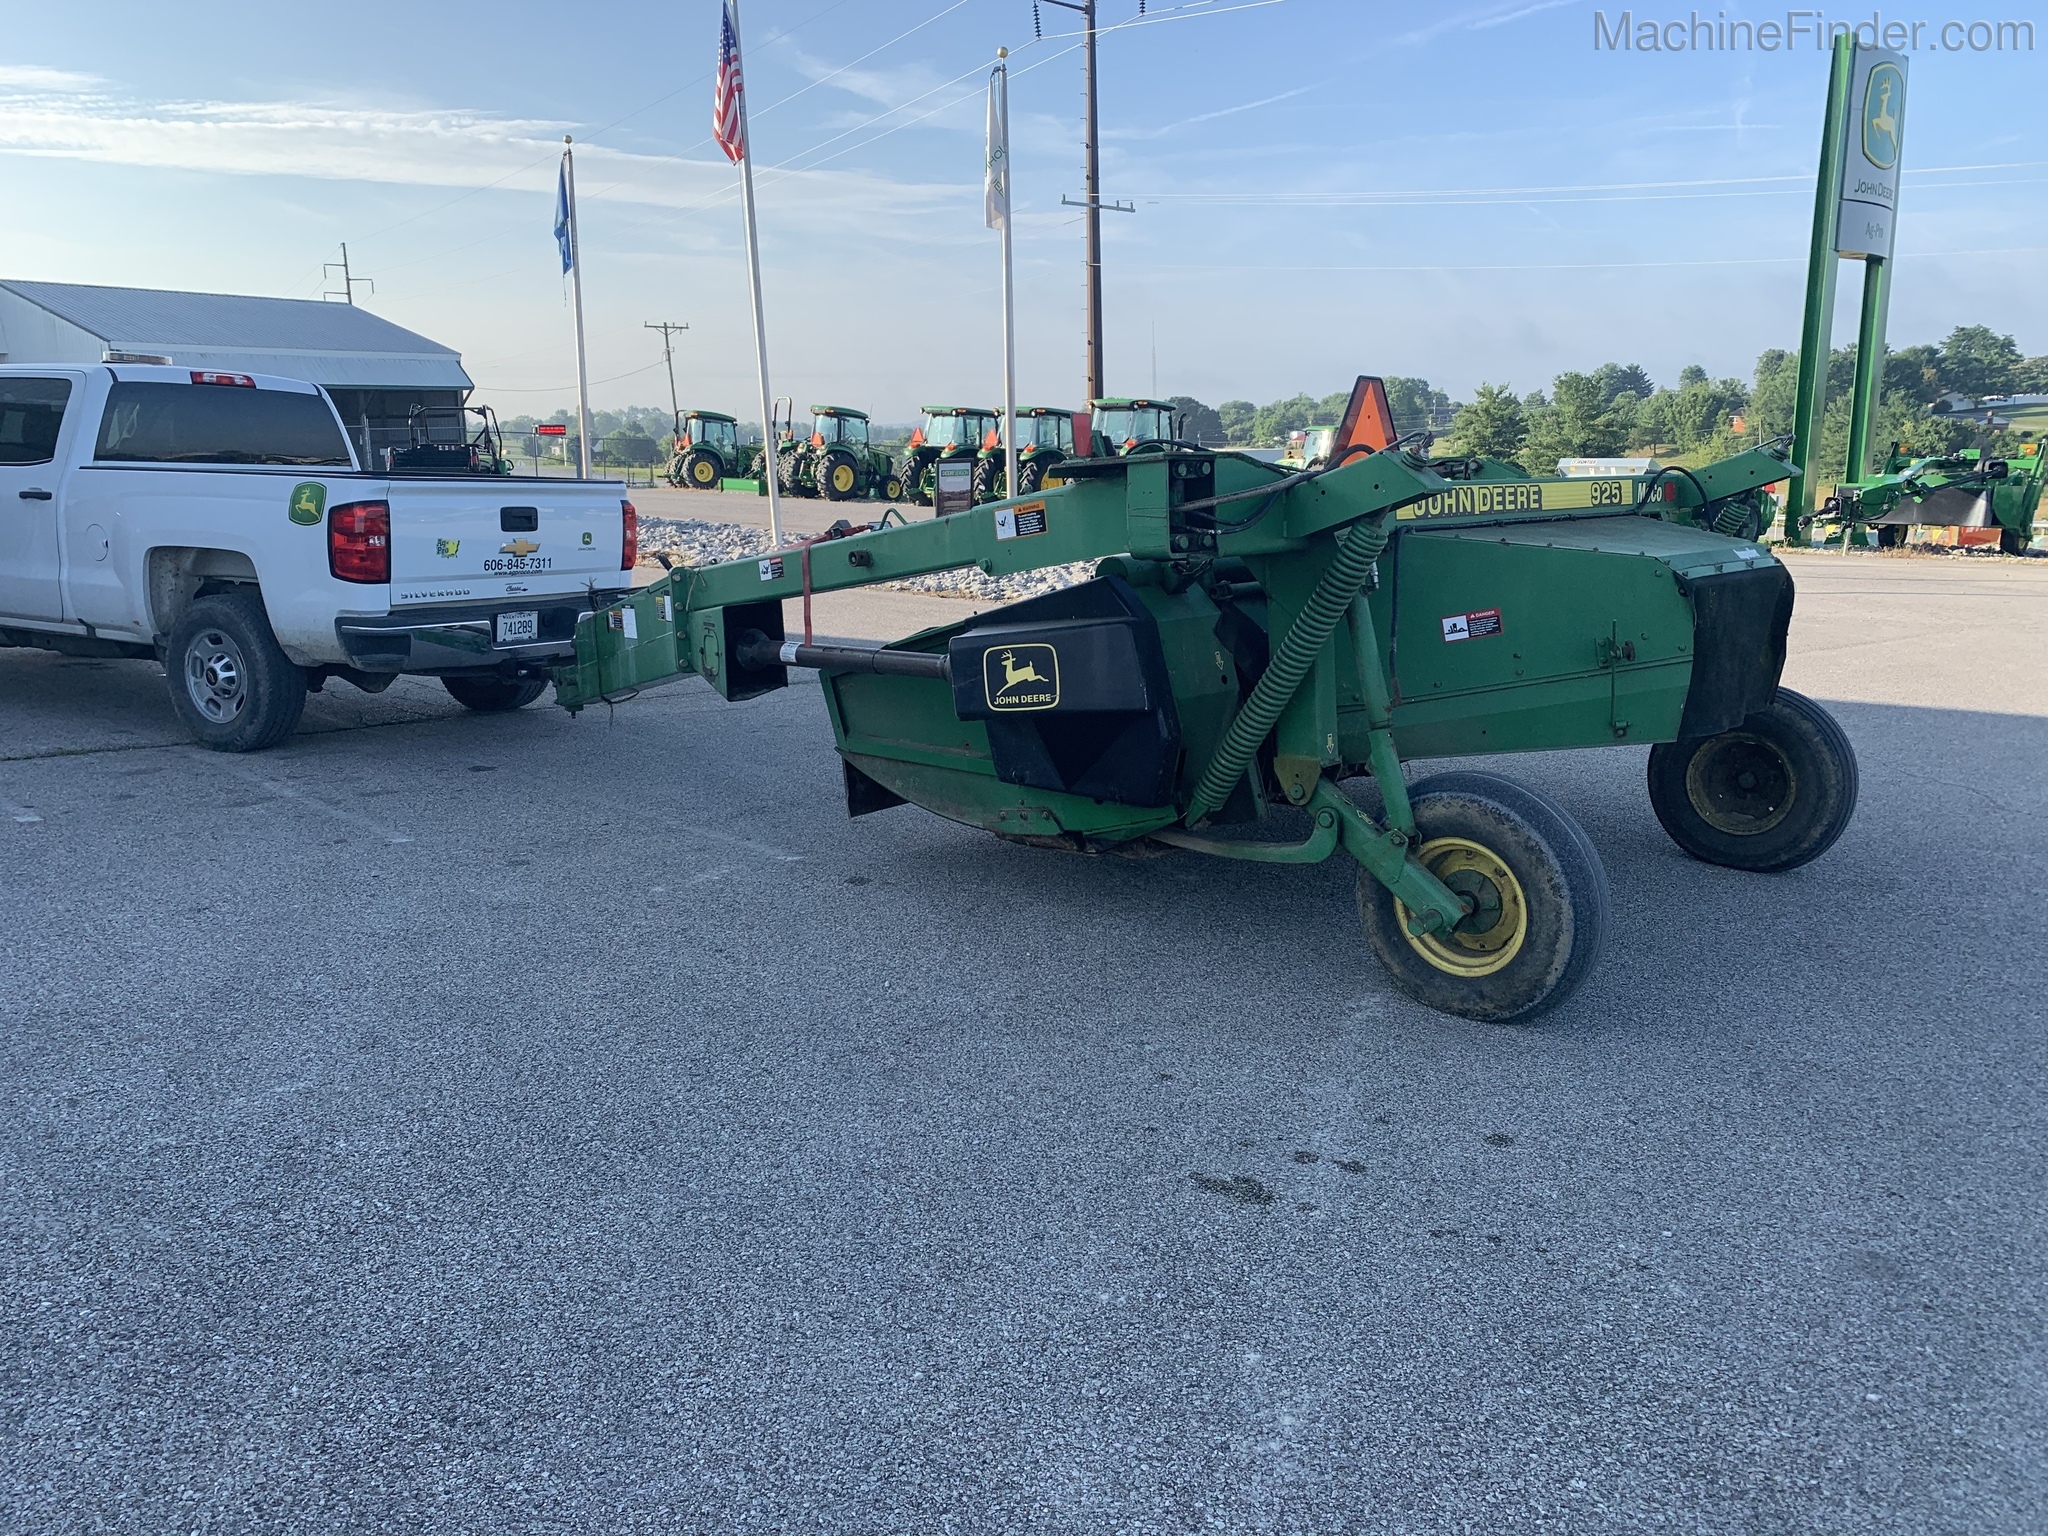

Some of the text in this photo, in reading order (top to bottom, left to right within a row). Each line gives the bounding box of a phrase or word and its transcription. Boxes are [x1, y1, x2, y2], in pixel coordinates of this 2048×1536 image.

[1854, 178, 1878, 196] JOHN
[1414, 484, 1541, 516] JOHN DEERE
[1591, 481, 1621, 506] 925
[483, 557, 552, 572] 606-845-7311
[401, 588, 471, 599] SILVERADO
[503, 619, 533, 636] 741289
[993, 693, 1052, 705] JOHN DEERE
